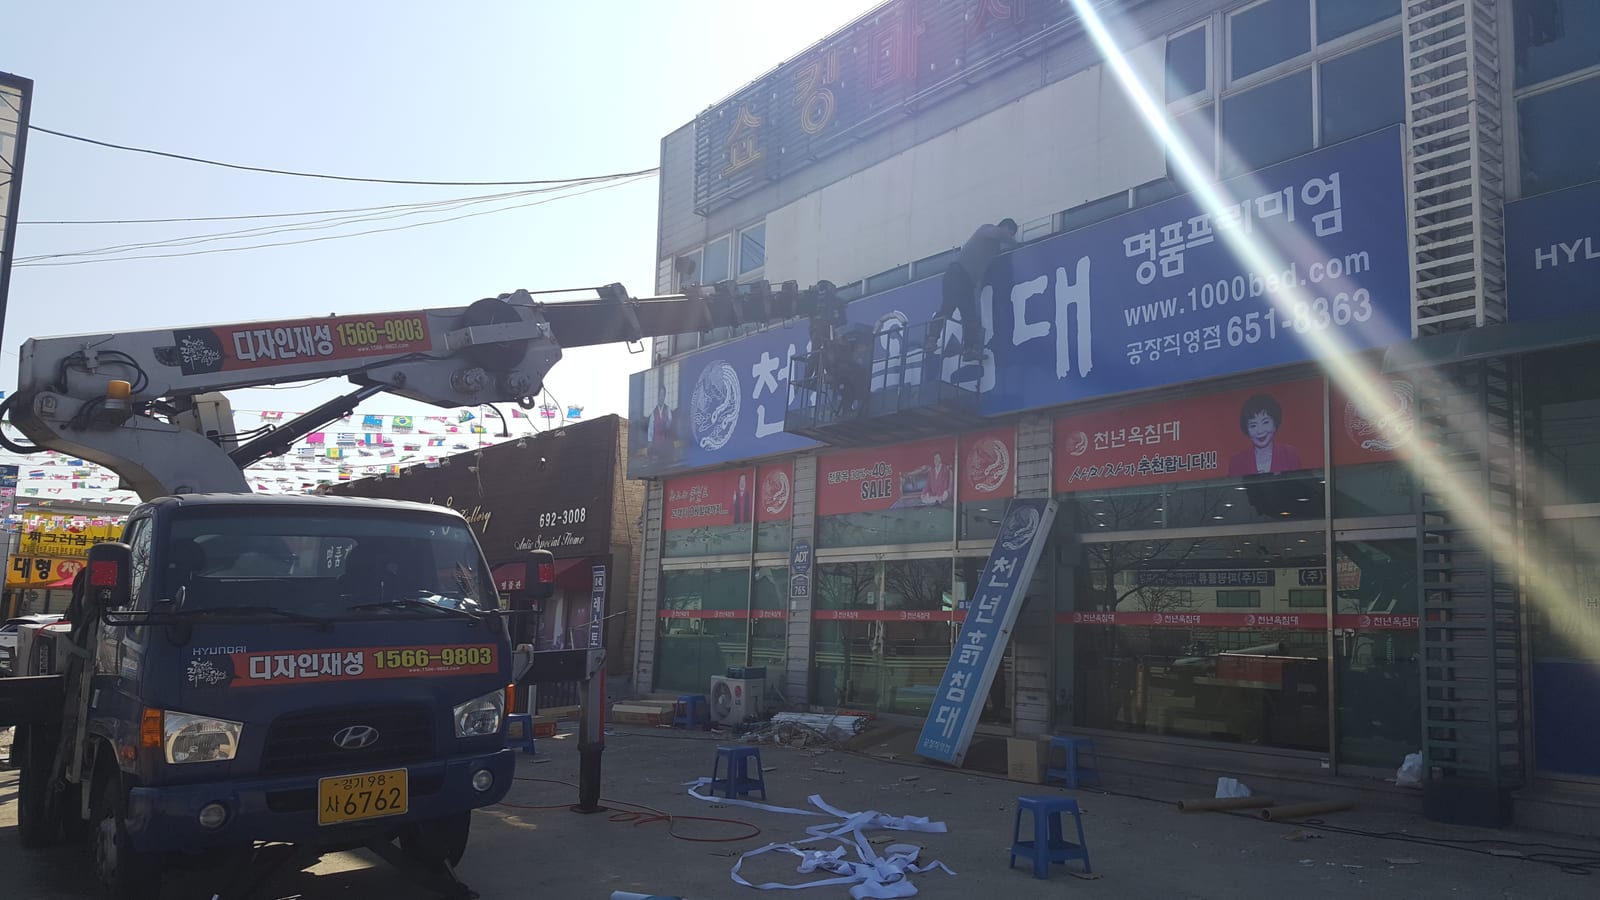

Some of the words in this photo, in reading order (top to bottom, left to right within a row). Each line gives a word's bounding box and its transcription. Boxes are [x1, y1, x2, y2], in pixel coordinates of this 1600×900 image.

[1123, 250, 1371, 327] www.1000bed.com
[232, 324, 334, 361] 디자인재성
[336, 318, 424, 347] 1566-9803
[1126, 325, 1221, 365] 공장직영점
[1226, 288, 1373, 347] 651-8363
[1093, 420, 1181, 451] 천년옥침대
[1137, 451, 1218, 475] 추천합니다!!
[861, 479, 893, 500] SALE
[539, 508, 586, 527] 692-3008
[794, 551, 809, 564] ADT
[1257, 613, 1299, 626] 천년옥침대
[193, 646, 247, 655] HYUNDAI
[935, 556, 1018, 738] 천년흙침대
[249, 651, 364, 679] 디자인재성
[373, 647, 493, 670] 1566-9803
[343, 775, 367, 790] 경기
[368, 776, 387, 787] 98
[326, 797, 341, 813] 사
[344, 787, 401, 816] 6762
